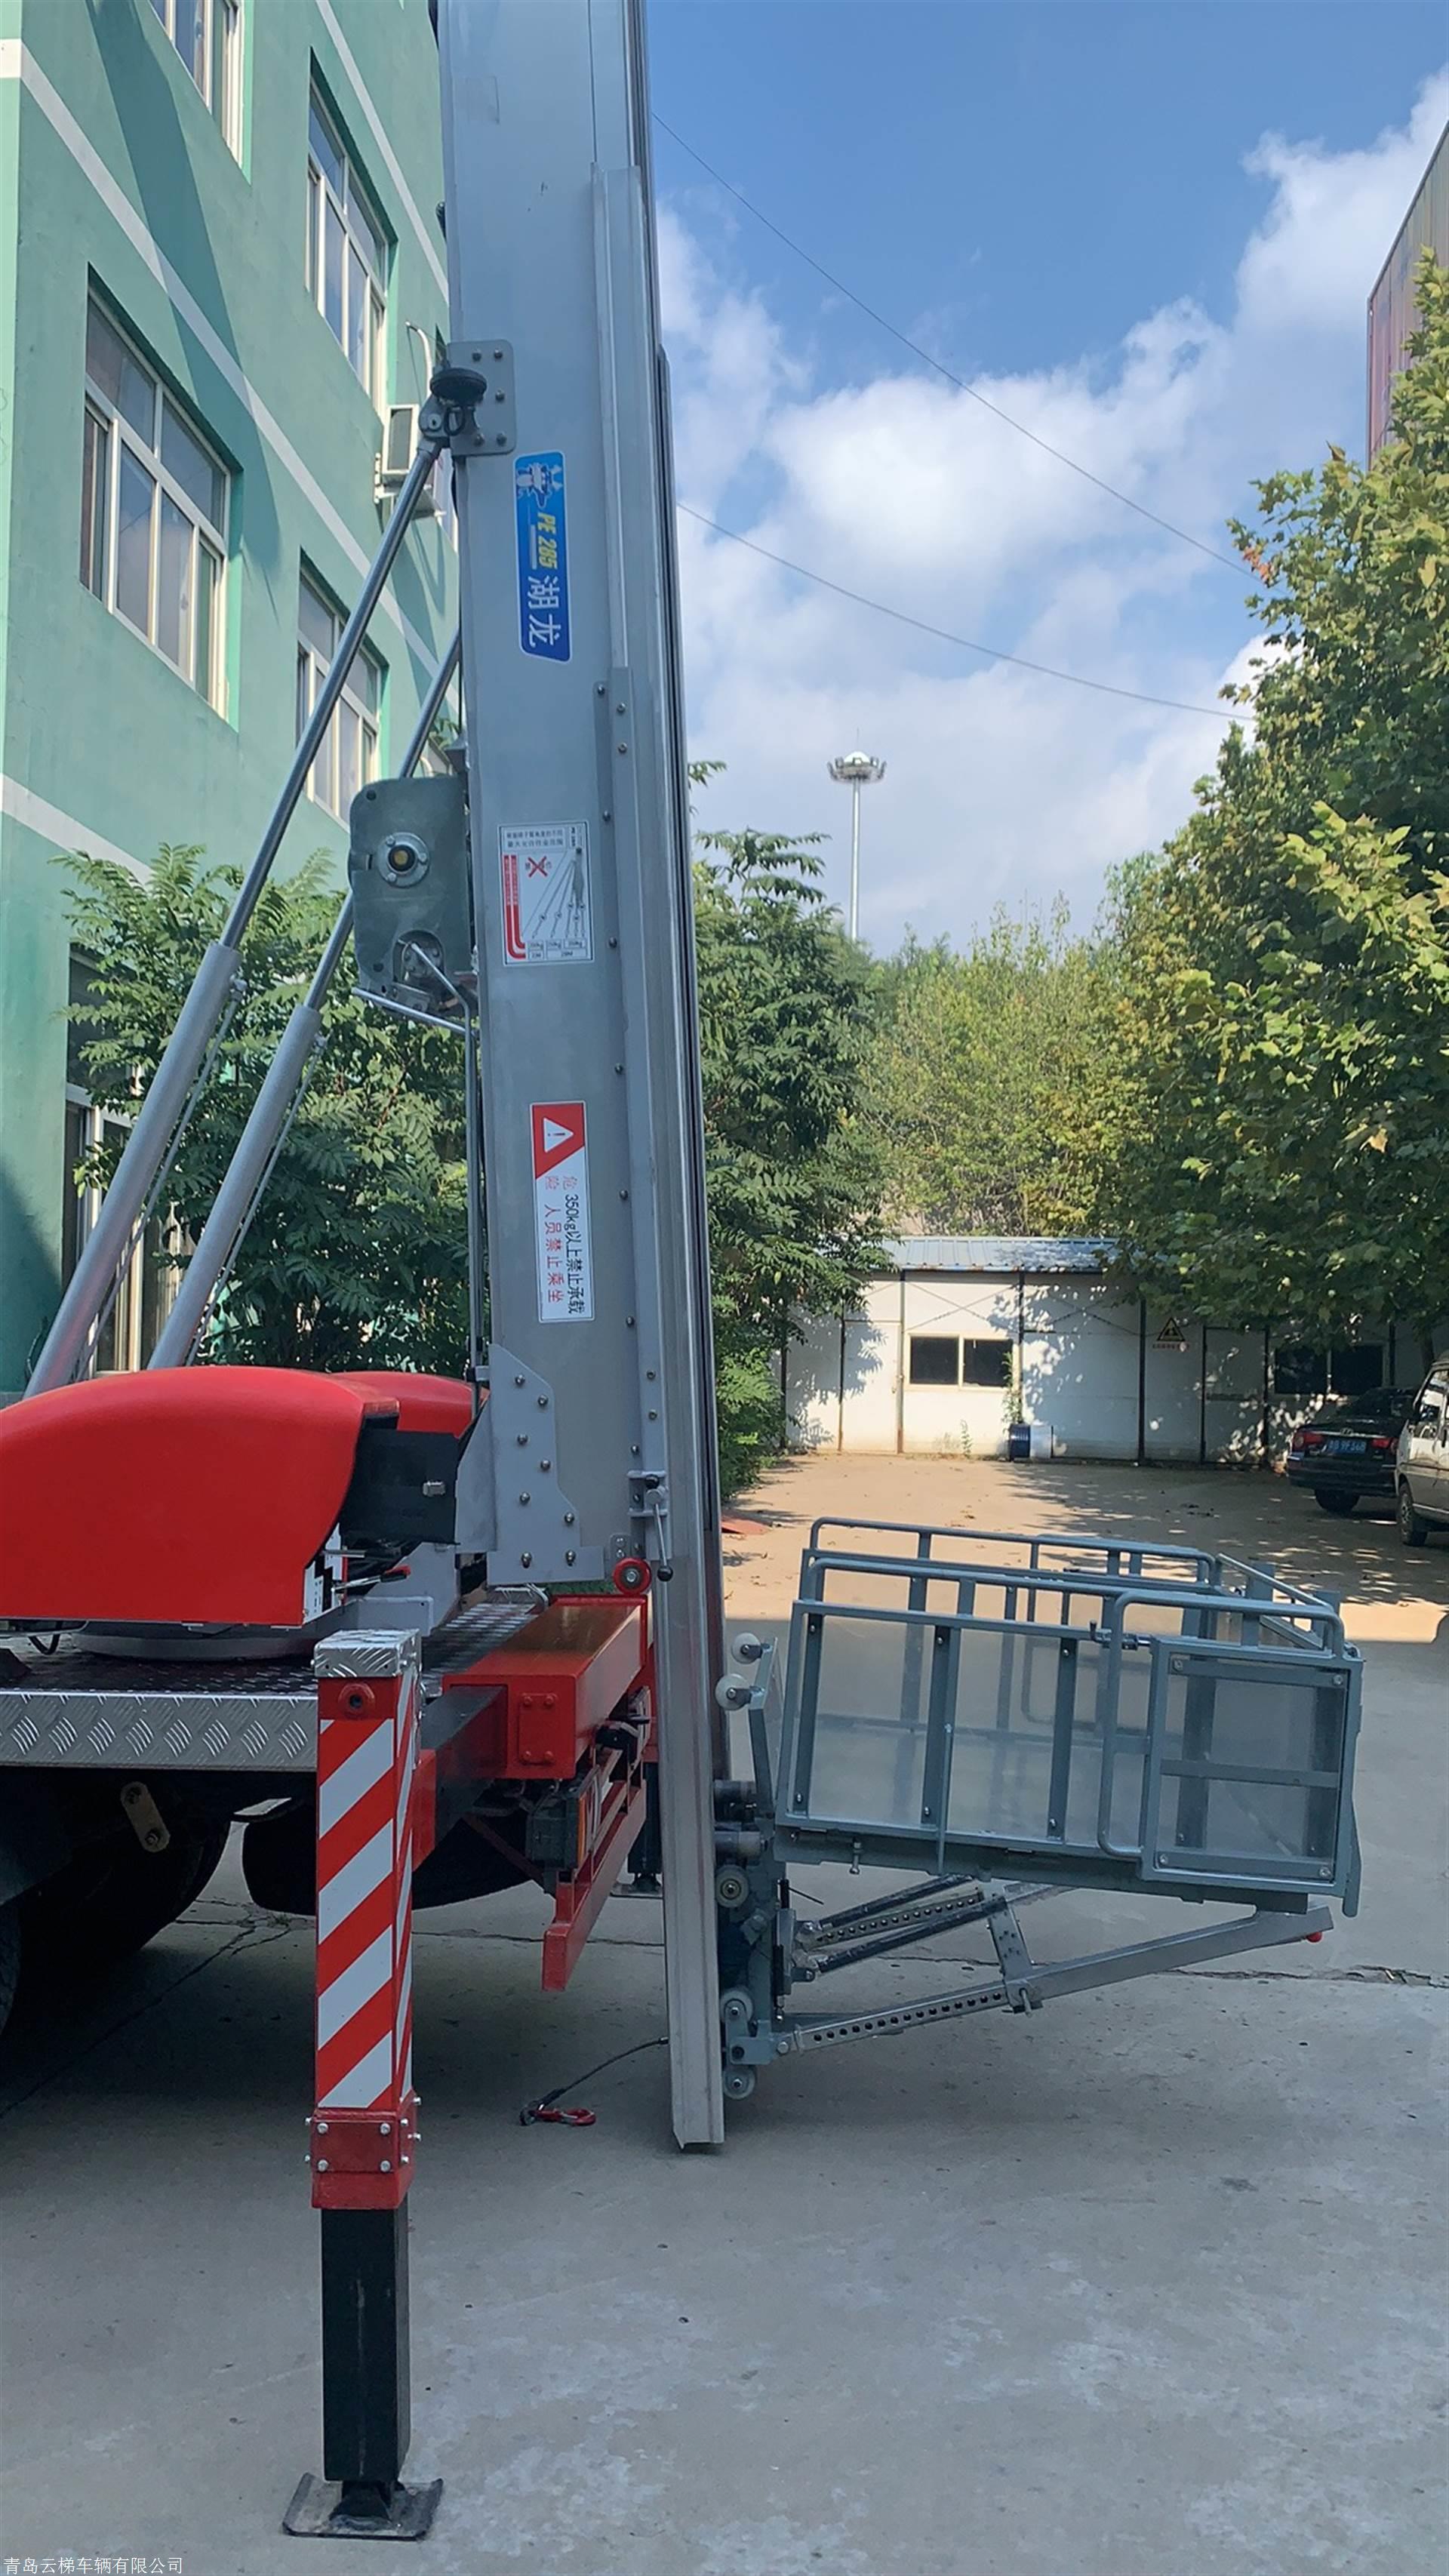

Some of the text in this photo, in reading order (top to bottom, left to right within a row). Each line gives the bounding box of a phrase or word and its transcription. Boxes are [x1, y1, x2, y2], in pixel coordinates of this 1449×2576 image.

[537, 511, 558, 569] PE 285
[528, 575, 561, 648] 湖龙
[545, 1175, 578, 1191] 危险
[543, 1204, 565, 1303] 人员禁止乘坐
[564, 1193, 586, 1314] 350kg以上禁止承载
